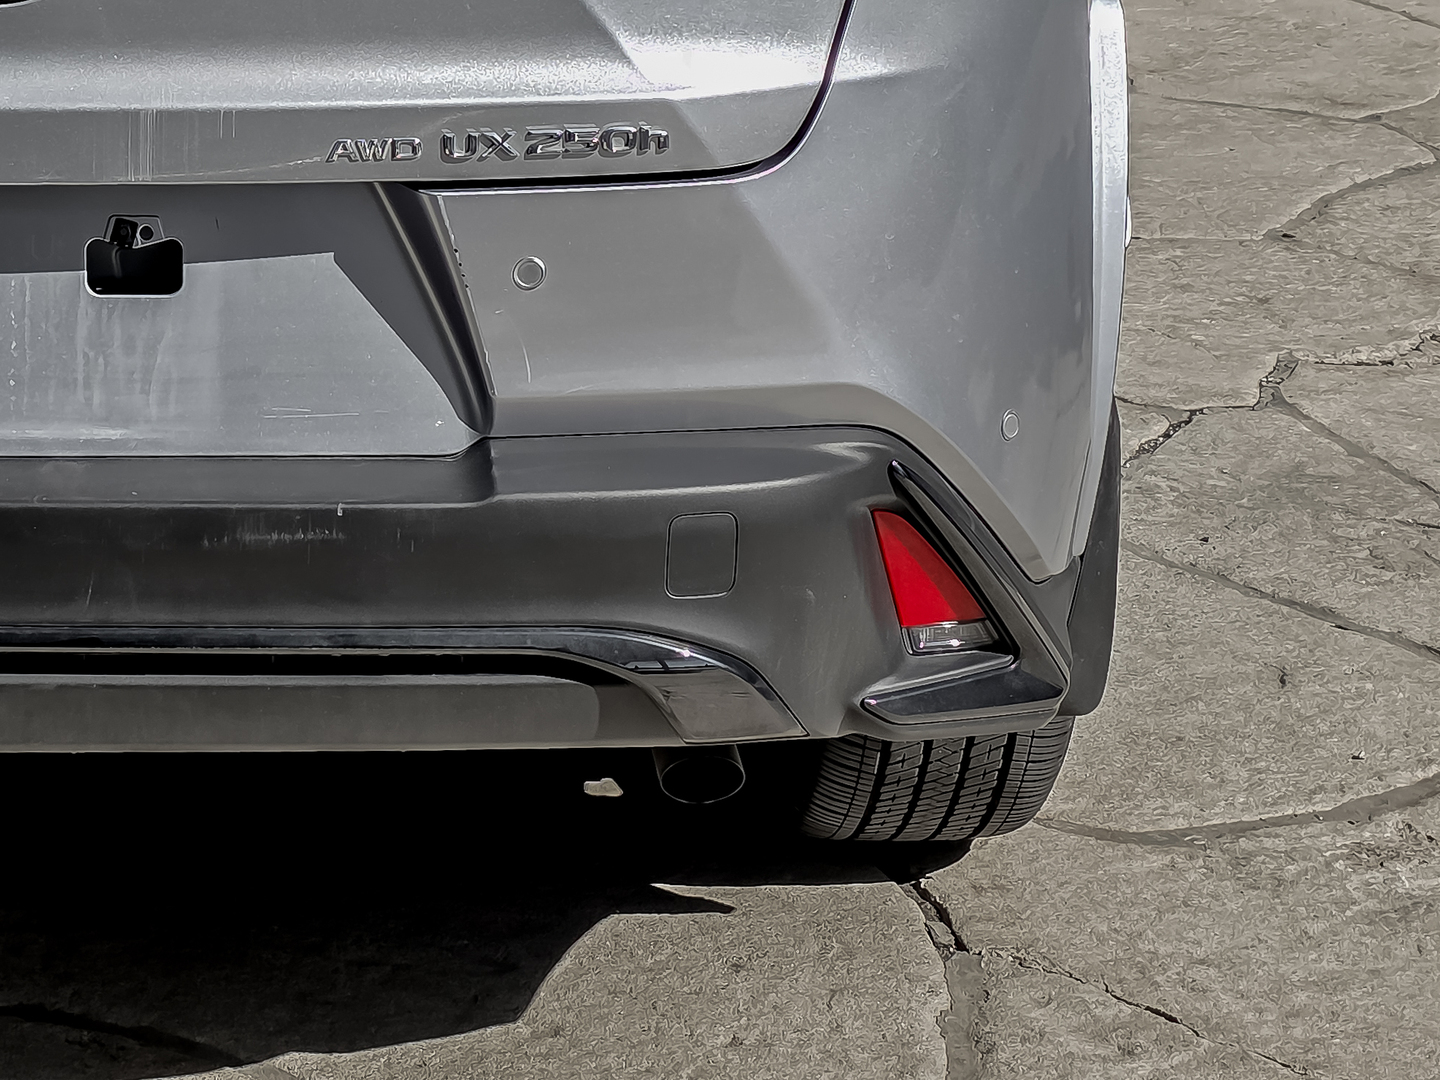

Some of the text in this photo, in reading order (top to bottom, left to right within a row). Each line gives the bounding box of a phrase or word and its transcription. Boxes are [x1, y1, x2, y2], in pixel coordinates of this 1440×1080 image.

[325, 121, 669, 165] AWD UX 250h
